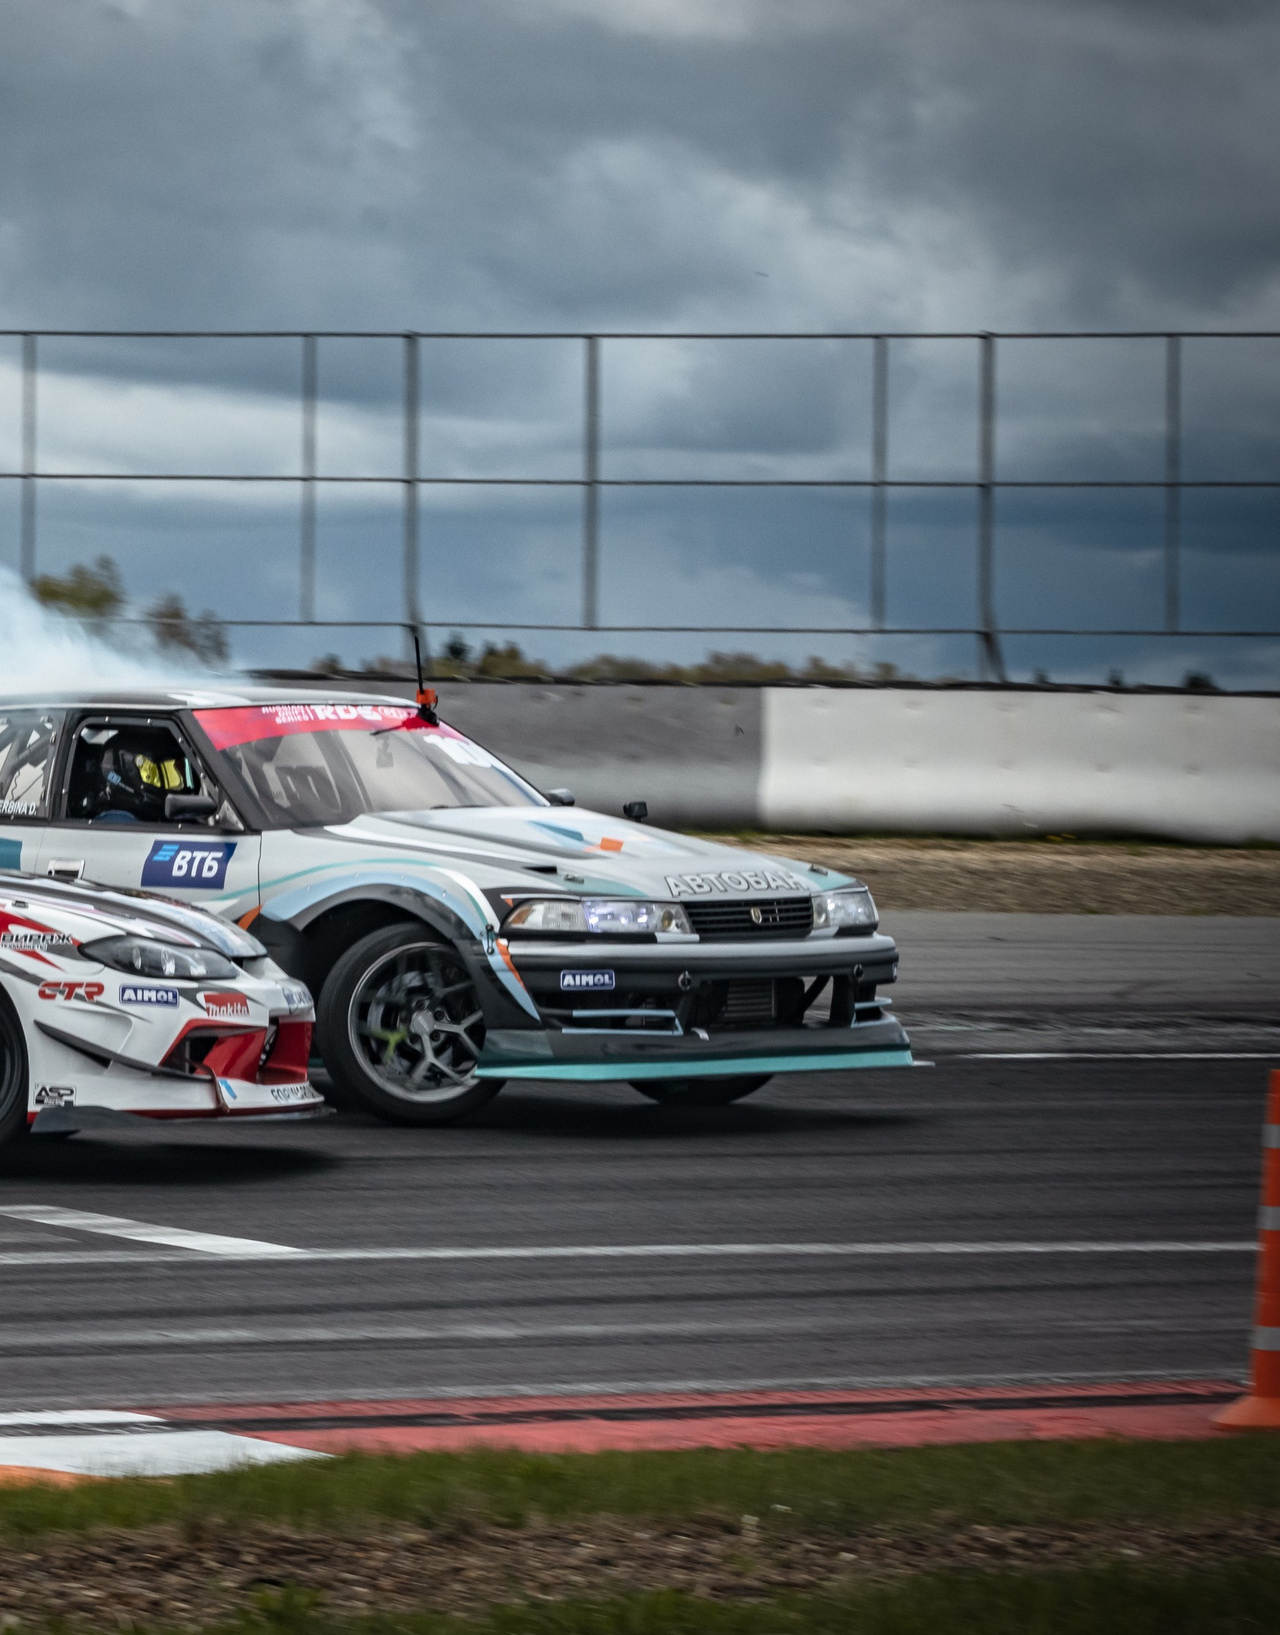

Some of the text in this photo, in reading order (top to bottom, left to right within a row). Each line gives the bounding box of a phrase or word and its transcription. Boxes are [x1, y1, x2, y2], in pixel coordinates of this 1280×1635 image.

[172, 850, 223, 878] ВТБ
[664, 870, 811, 898] АВТОБАН
[563, 973, 612, 987] AIMOL
[38, 981, 105, 1001] CTR
[122, 988, 178, 1004] AIMOL
